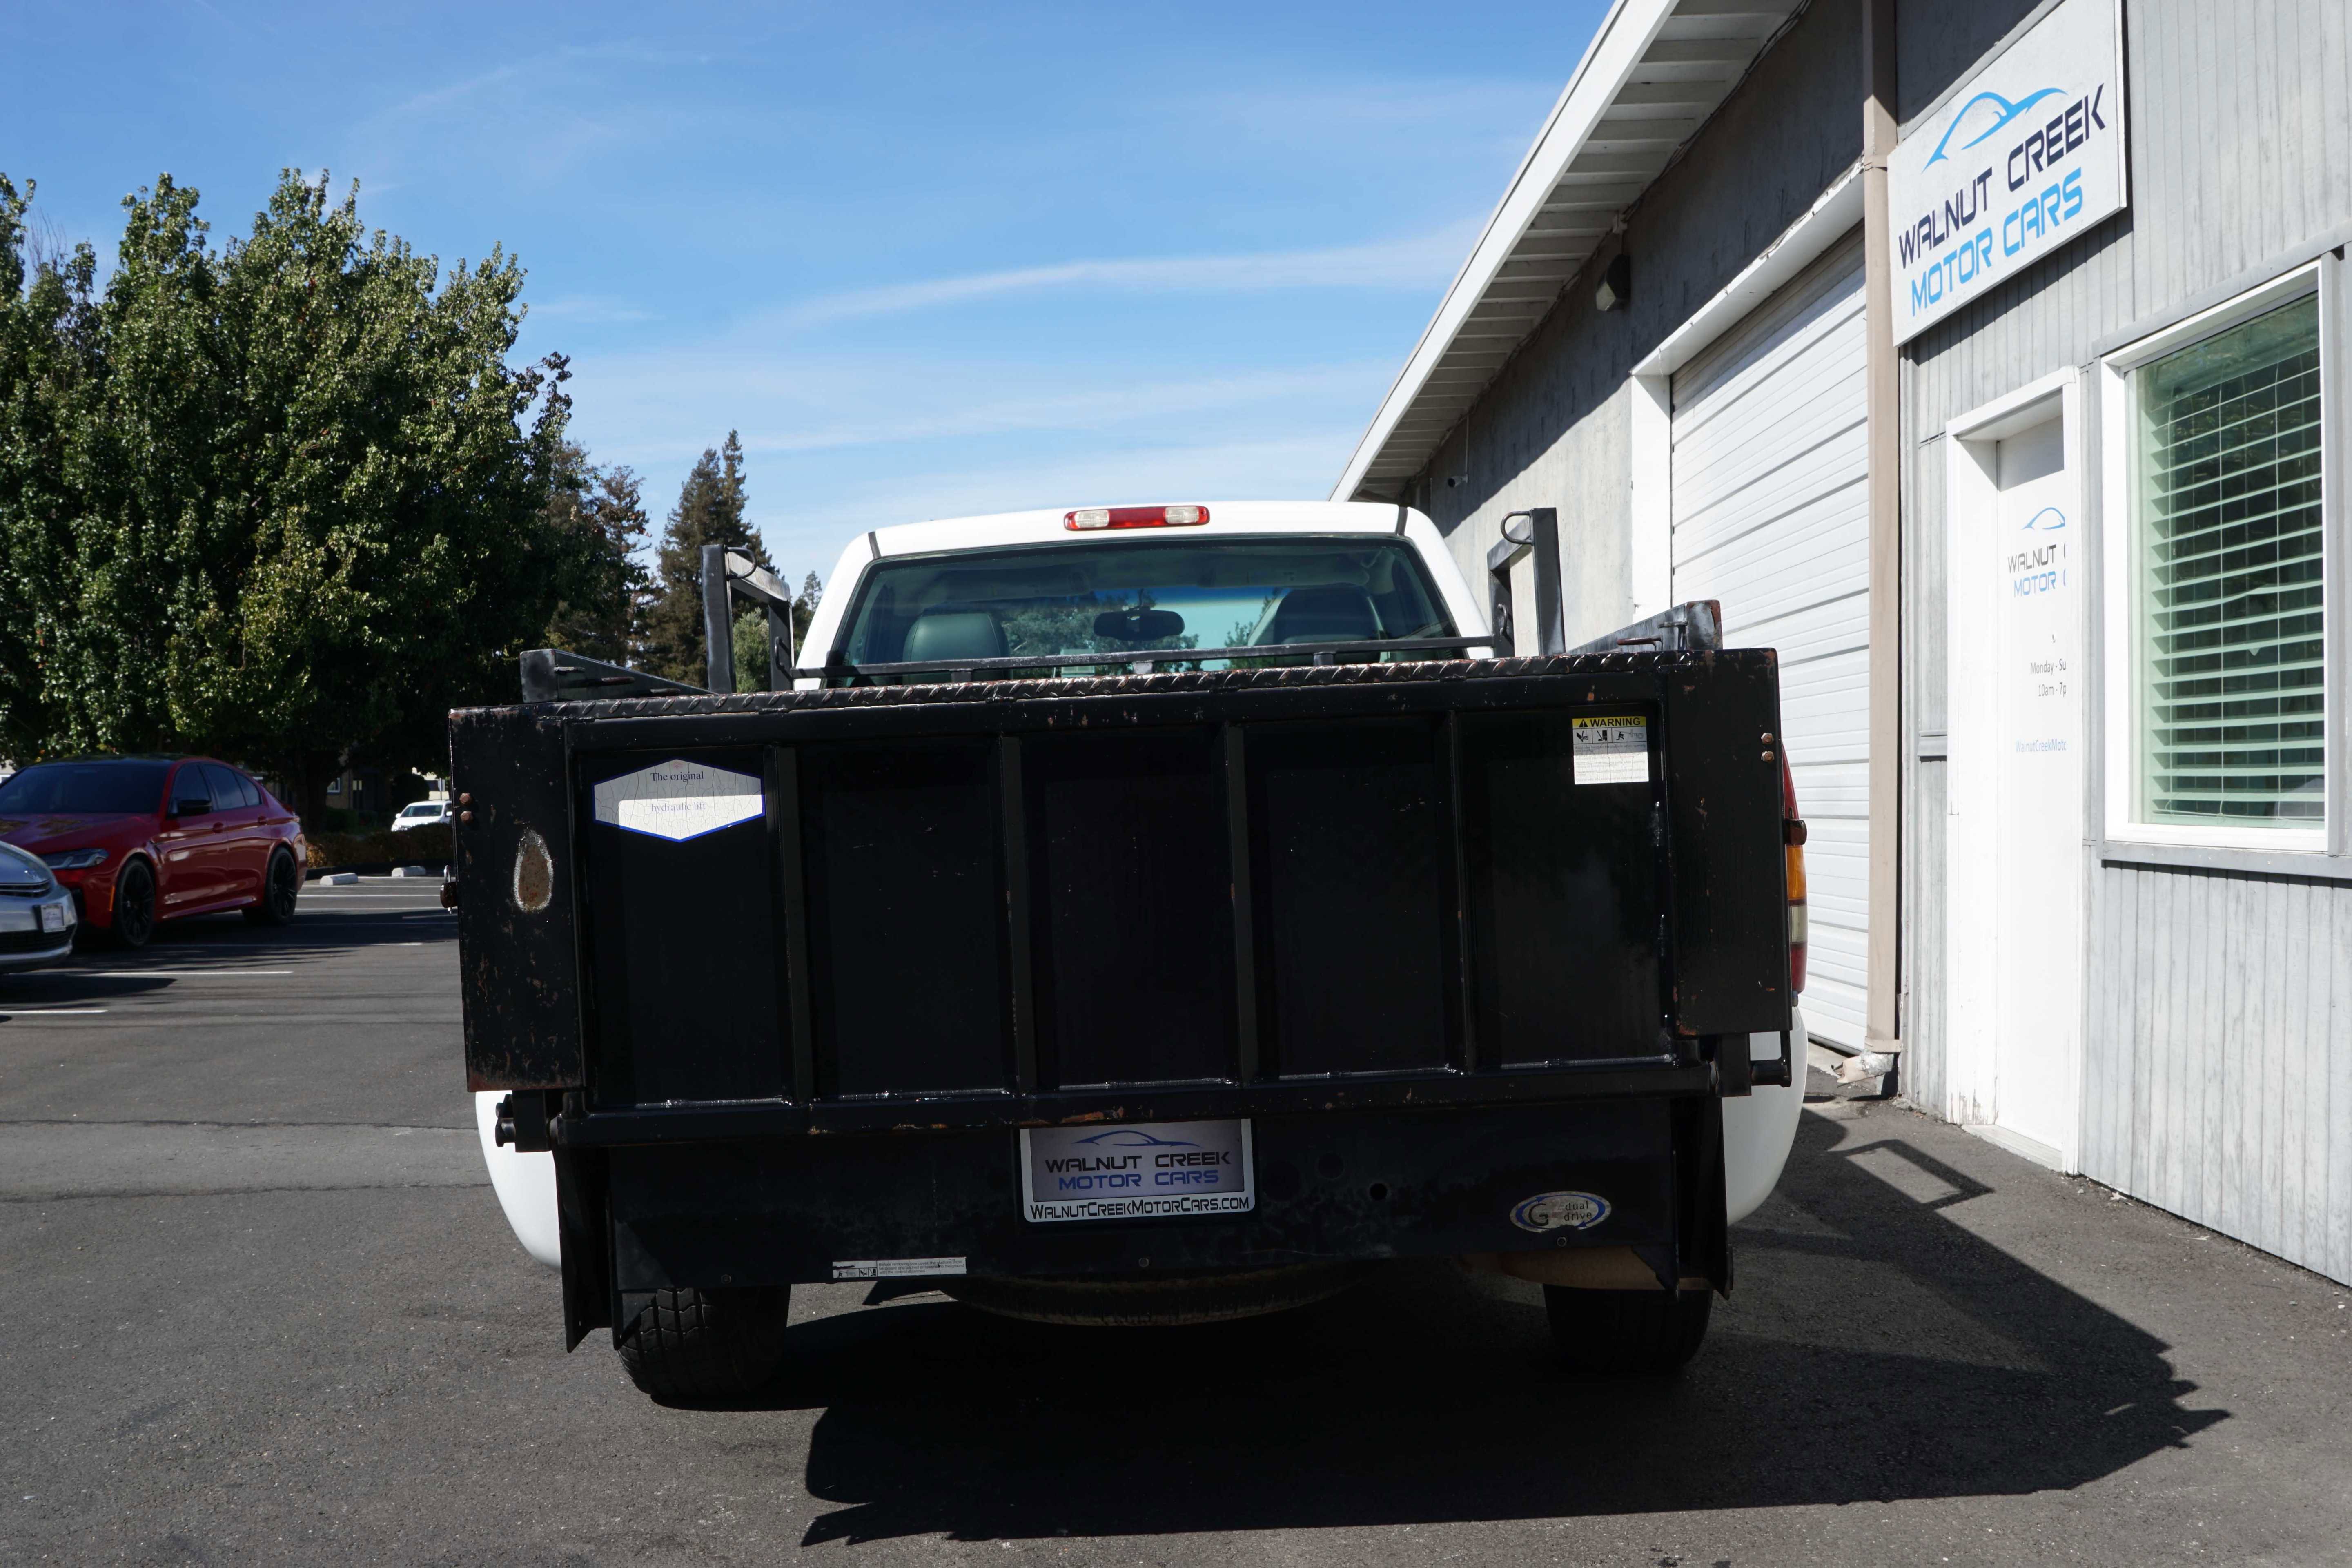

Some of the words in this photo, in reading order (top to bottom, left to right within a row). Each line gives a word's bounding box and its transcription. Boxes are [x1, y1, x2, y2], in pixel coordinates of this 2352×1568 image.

[1899, 167, 1993, 270] WALNUT
[2007, 83, 2106, 192] CREEK
[1912, 227, 1993, 317] MOTOR
[2002, 167, 2083, 258] CARS
[2007, 543, 2057, 574] WALNUT
[2013, 570, 2056, 598] MOTOR
[2030, 660, 2054, 676] Monday
[2038, 684, 2054, 697] 10am
[1590, 717, 1641, 727] WARNING
[650, 772, 668, 782] The
[670, 771, 704, 782] original
[650, 802, 692, 813] hydraulic
[693, 802, 706, 811] lift
[1045, 1155, 1143, 1174] WALNUT
[1155, 1151, 1232, 1168] CREEK
[1058, 1173, 1142, 1191] MOTOR
[1155, 1169, 1219, 1186] CARS
[1565, 1200, 1589, 1211] dual
[1564, 1211, 1592, 1222] drive
